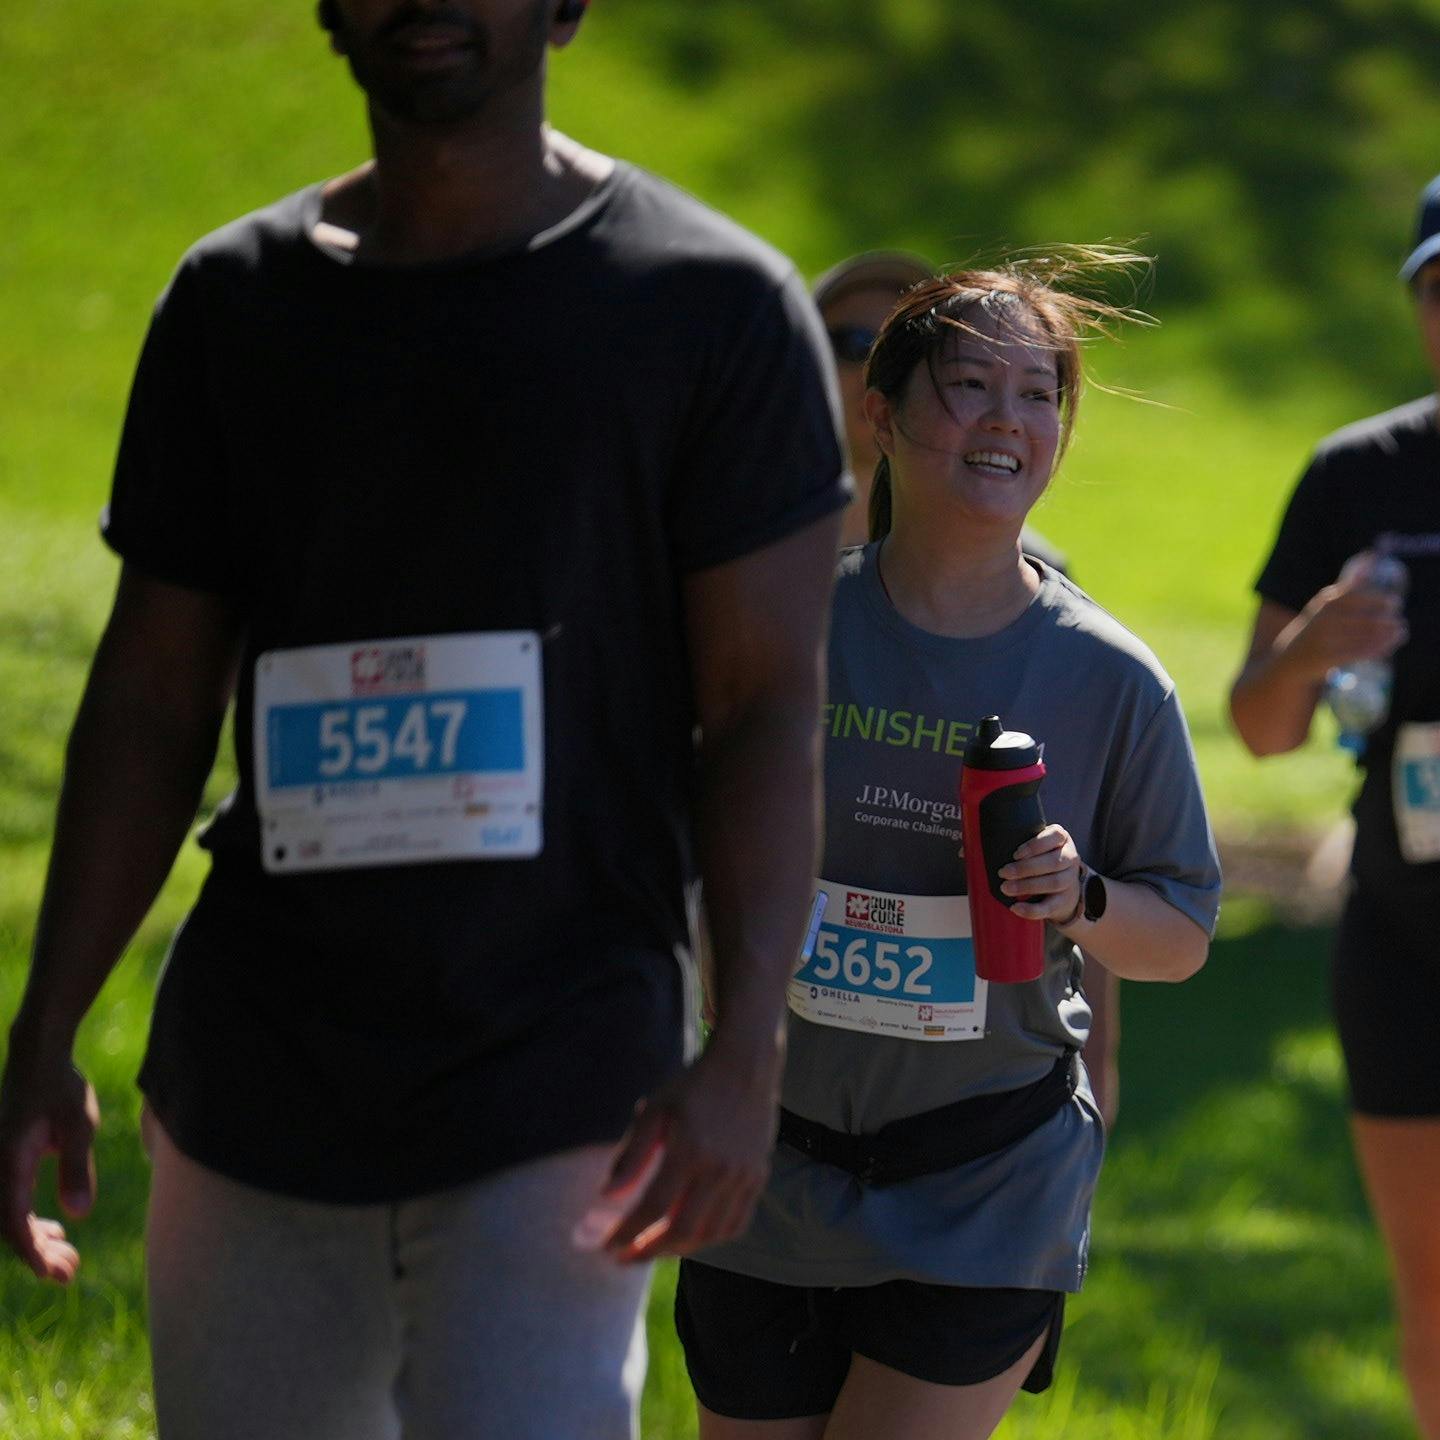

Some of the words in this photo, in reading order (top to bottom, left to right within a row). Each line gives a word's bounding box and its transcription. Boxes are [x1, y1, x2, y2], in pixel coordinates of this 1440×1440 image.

[318, 700, 467, 776] 5547
[821, 703, 981, 757] FINISHE
[854, 811, 911, 830] Corporate
[871, 909, 905, 927] CURE
[813, 930, 933, 995] 5652
[821, 988, 861, 1003] GHELLA
